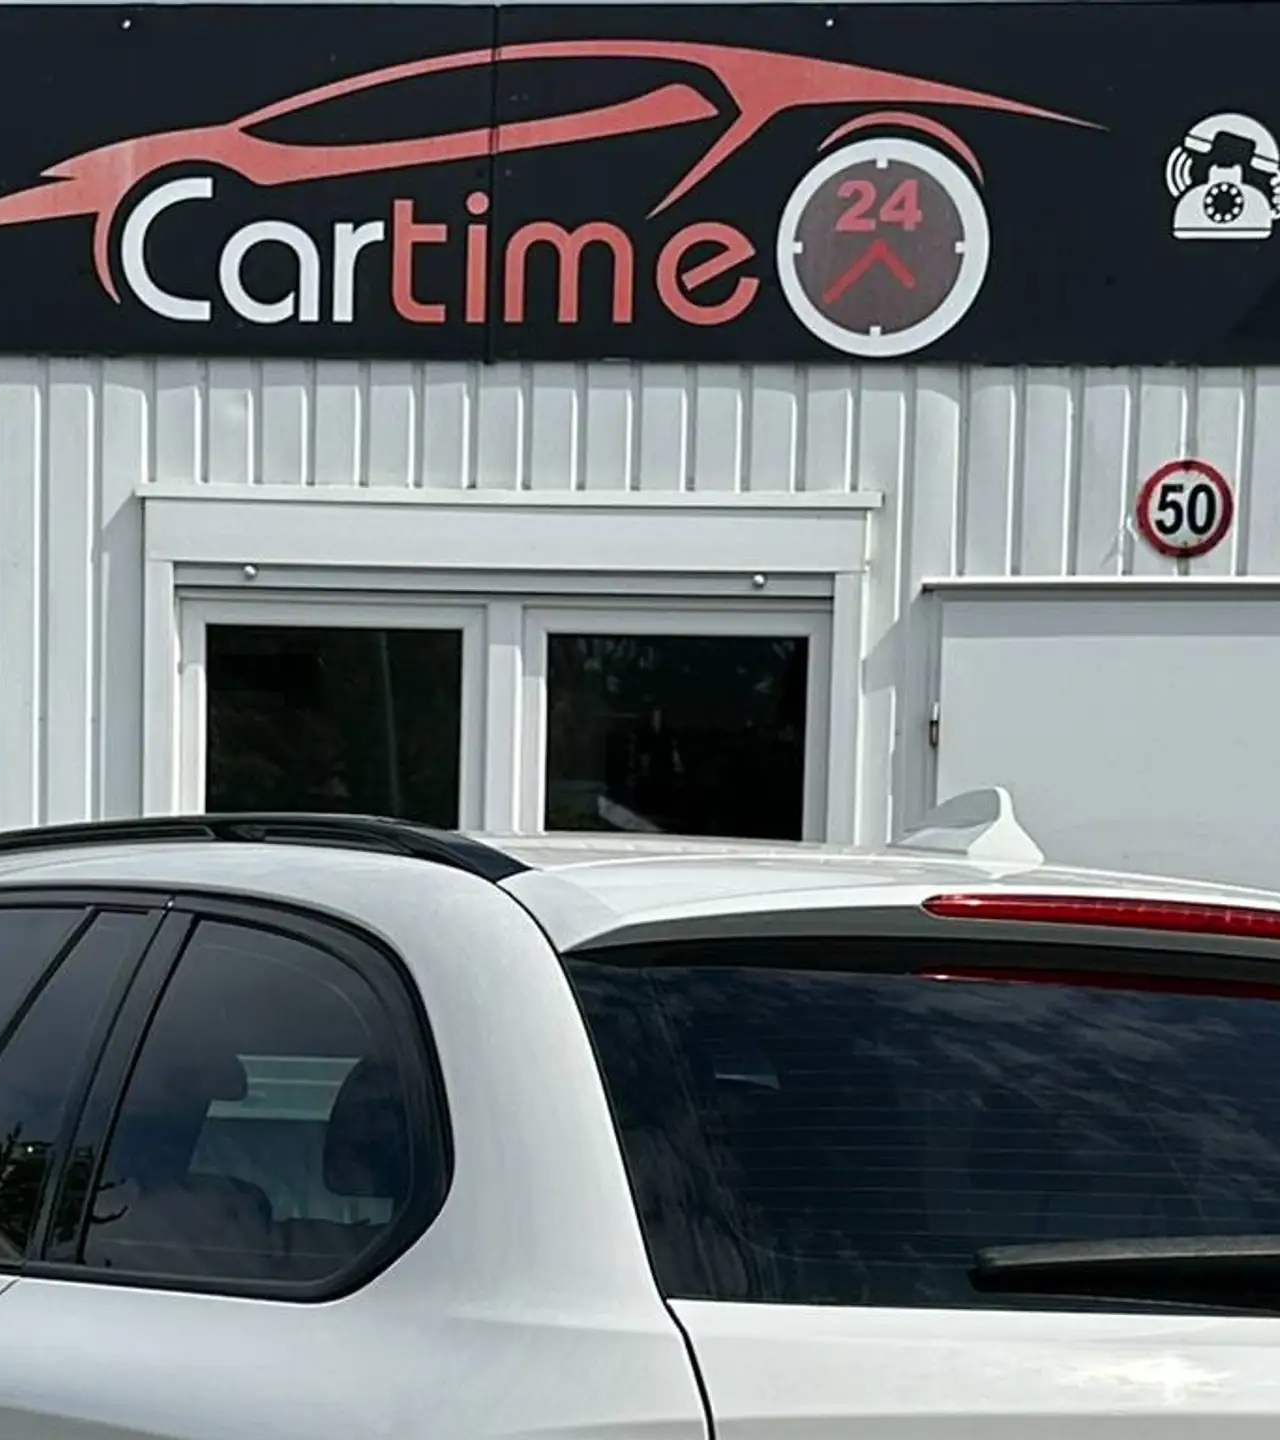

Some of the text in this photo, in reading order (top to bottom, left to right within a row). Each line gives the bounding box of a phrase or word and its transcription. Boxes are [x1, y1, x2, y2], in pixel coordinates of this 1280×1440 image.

[120, 176, 923, 325] Cartime 24
[1154, 483, 1217, 536] 50
